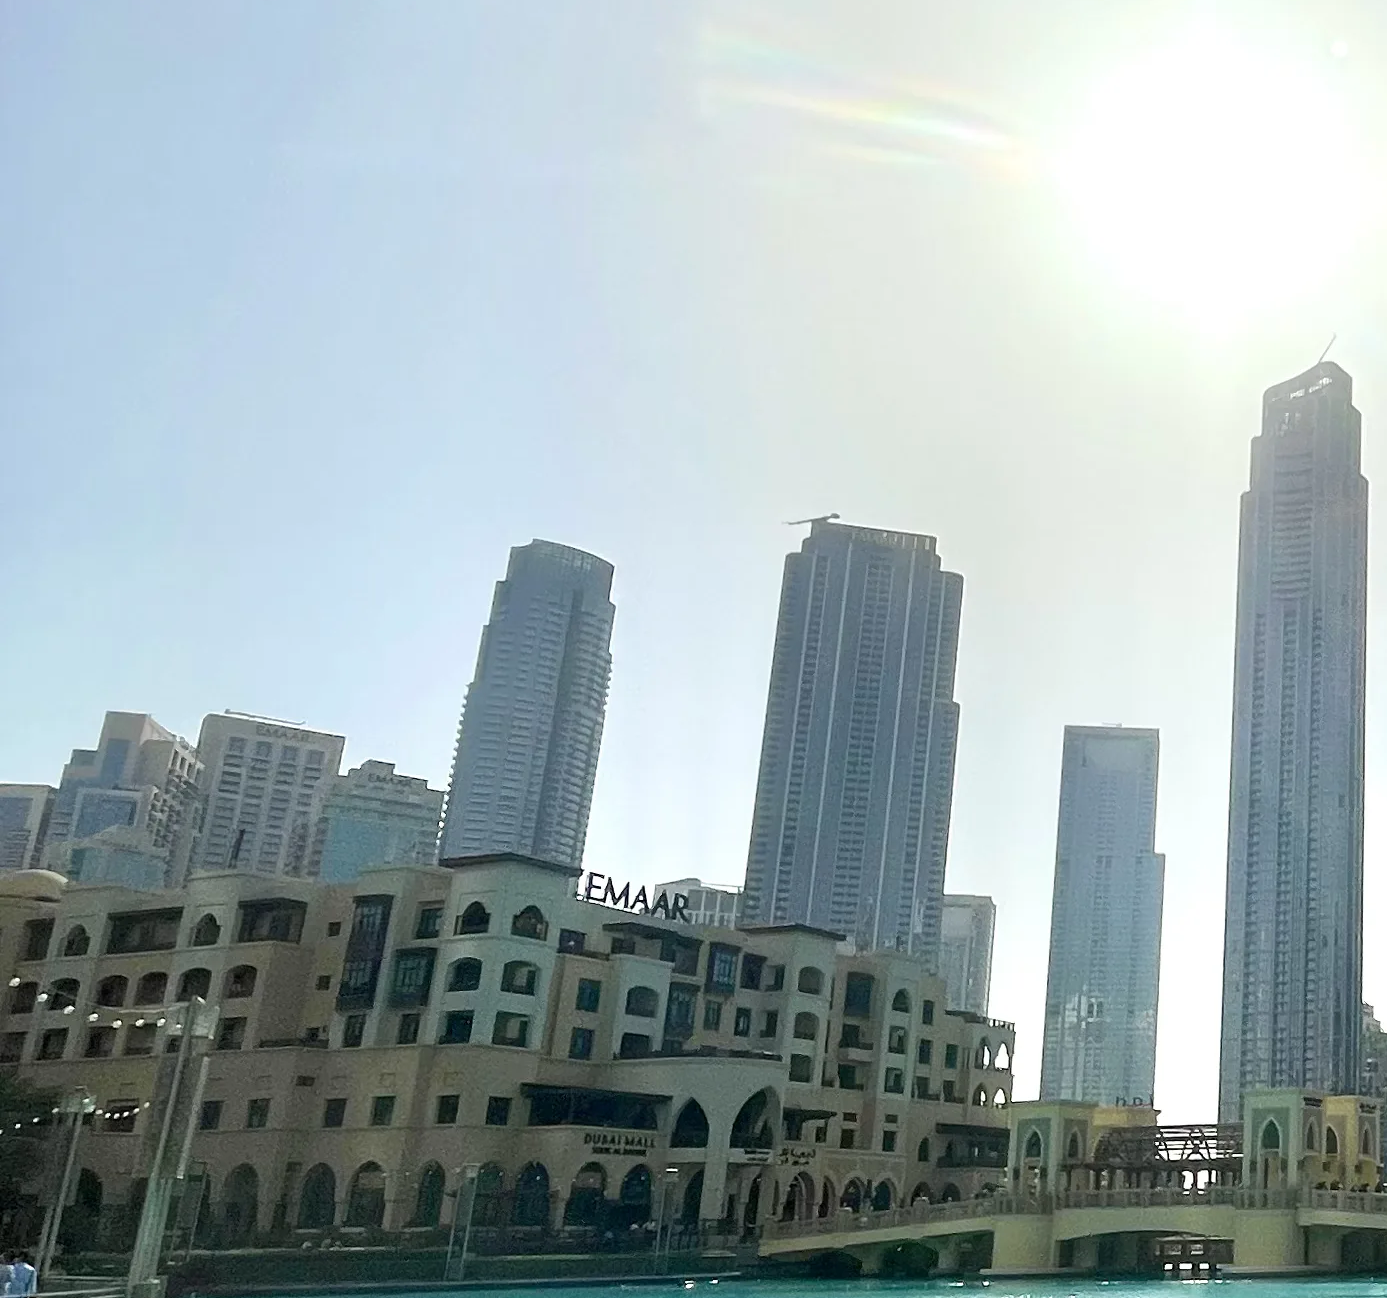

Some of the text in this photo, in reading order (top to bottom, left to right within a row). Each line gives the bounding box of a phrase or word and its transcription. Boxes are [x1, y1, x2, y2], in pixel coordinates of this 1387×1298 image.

[586, 871, 690, 924] EMAAR
[584, 1133, 656, 1149] DUBAI MALL
